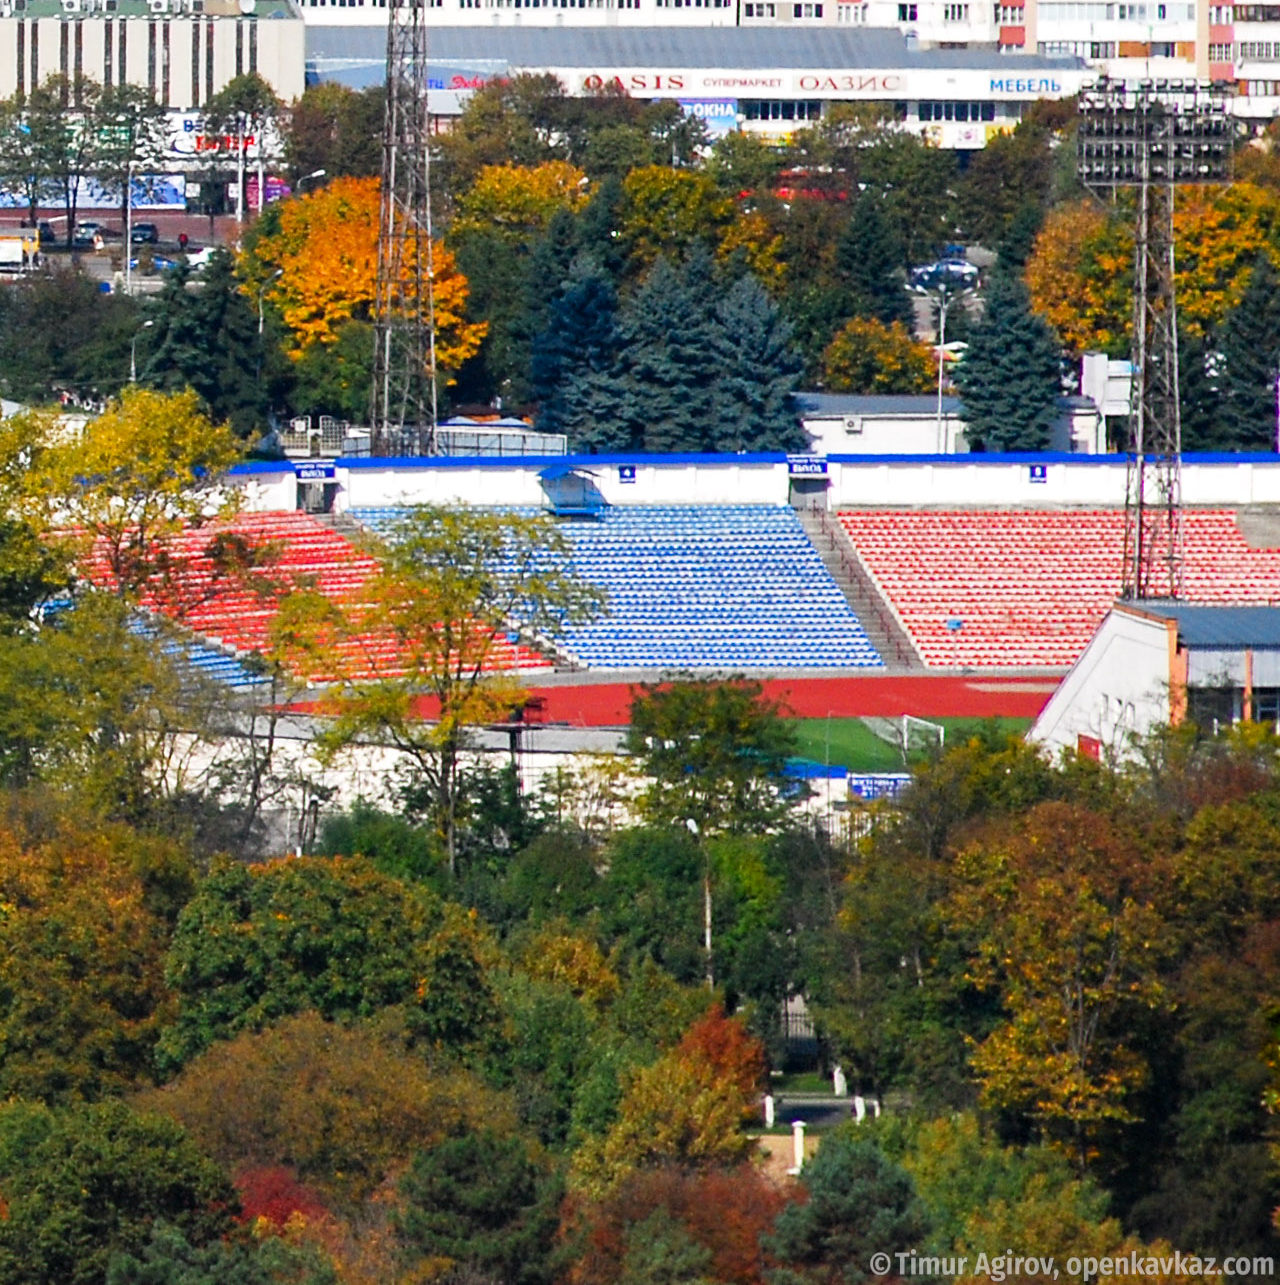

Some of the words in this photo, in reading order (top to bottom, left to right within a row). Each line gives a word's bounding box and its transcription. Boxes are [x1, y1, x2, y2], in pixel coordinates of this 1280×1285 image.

[582, 74, 684, 90] OASIS
[703, 78, 782, 88] СУПЕРМАРКЕТ
[799, 75, 901, 91] ОАЗИС
[990, 78, 1061, 93] МЕБЕЛЬ
